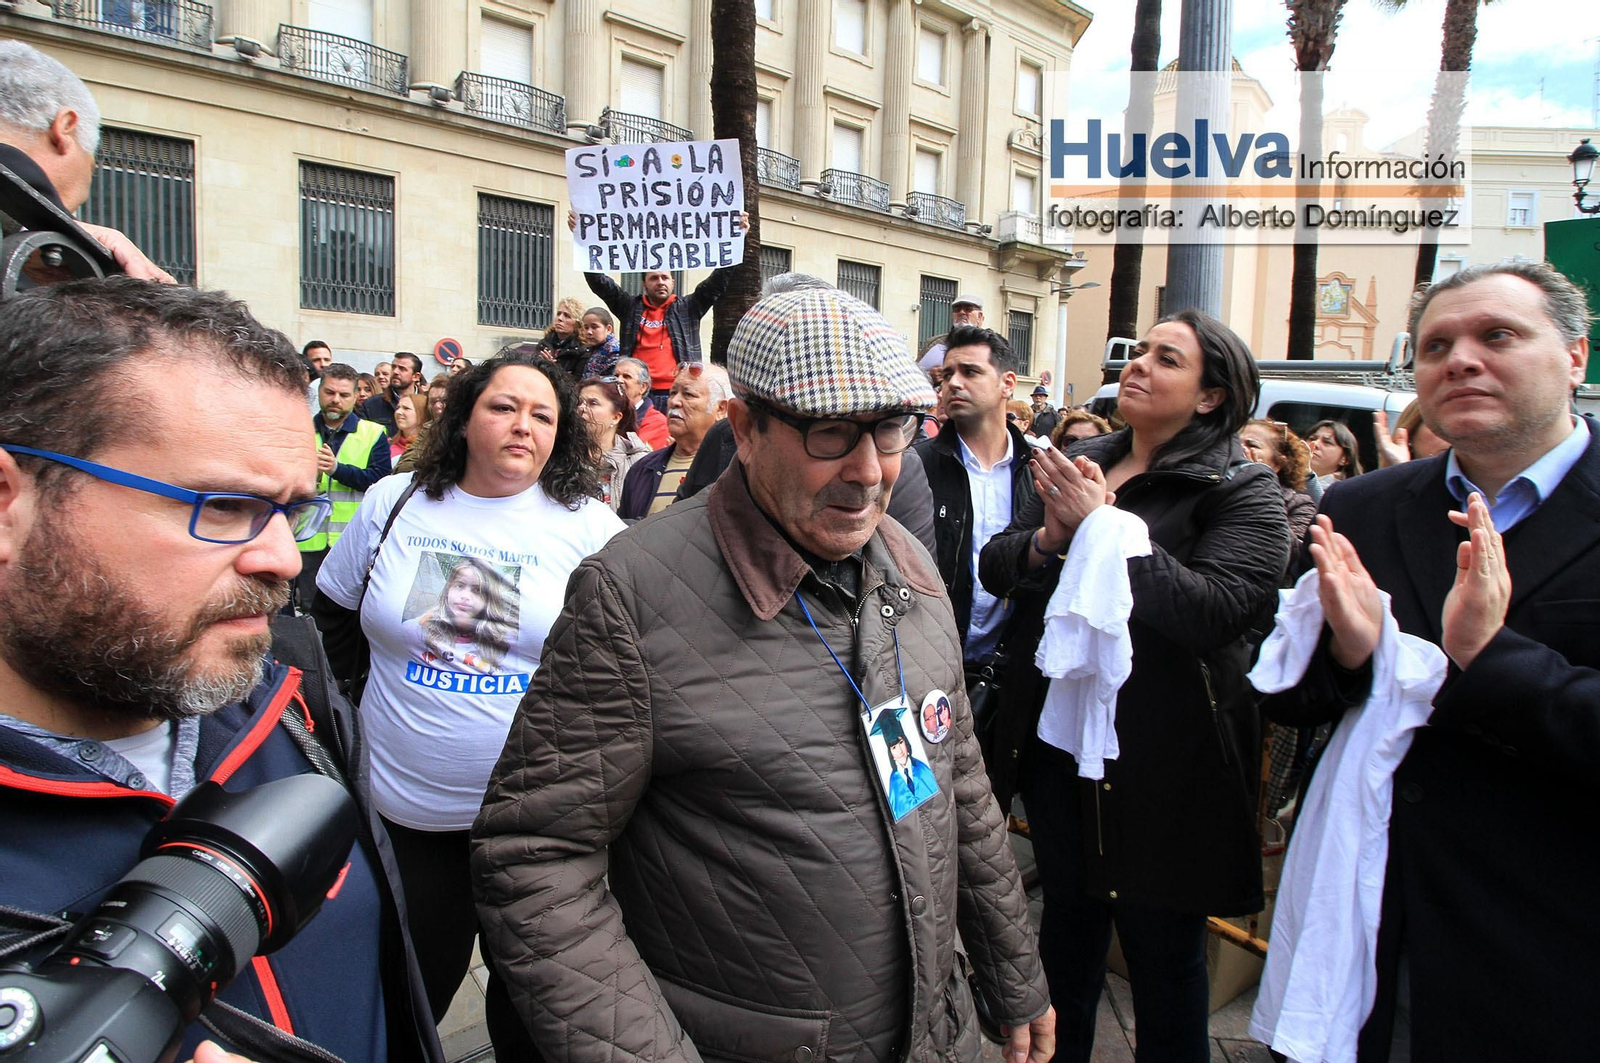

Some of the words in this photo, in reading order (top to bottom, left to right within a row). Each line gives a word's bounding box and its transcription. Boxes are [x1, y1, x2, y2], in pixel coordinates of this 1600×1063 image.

[642, 147, 662, 176] A
[688, 143, 723, 175] LA
[579, 210, 742, 241] PERMANENTE
[588, 240, 733, 271] REVISABLE
[407, 535, 447, 550] TODOS
[450, 539, 495, 559] SOMOS
[499, 550, 539, 567] MARTA
[409, 665, 523, 694] JUSTICIA
